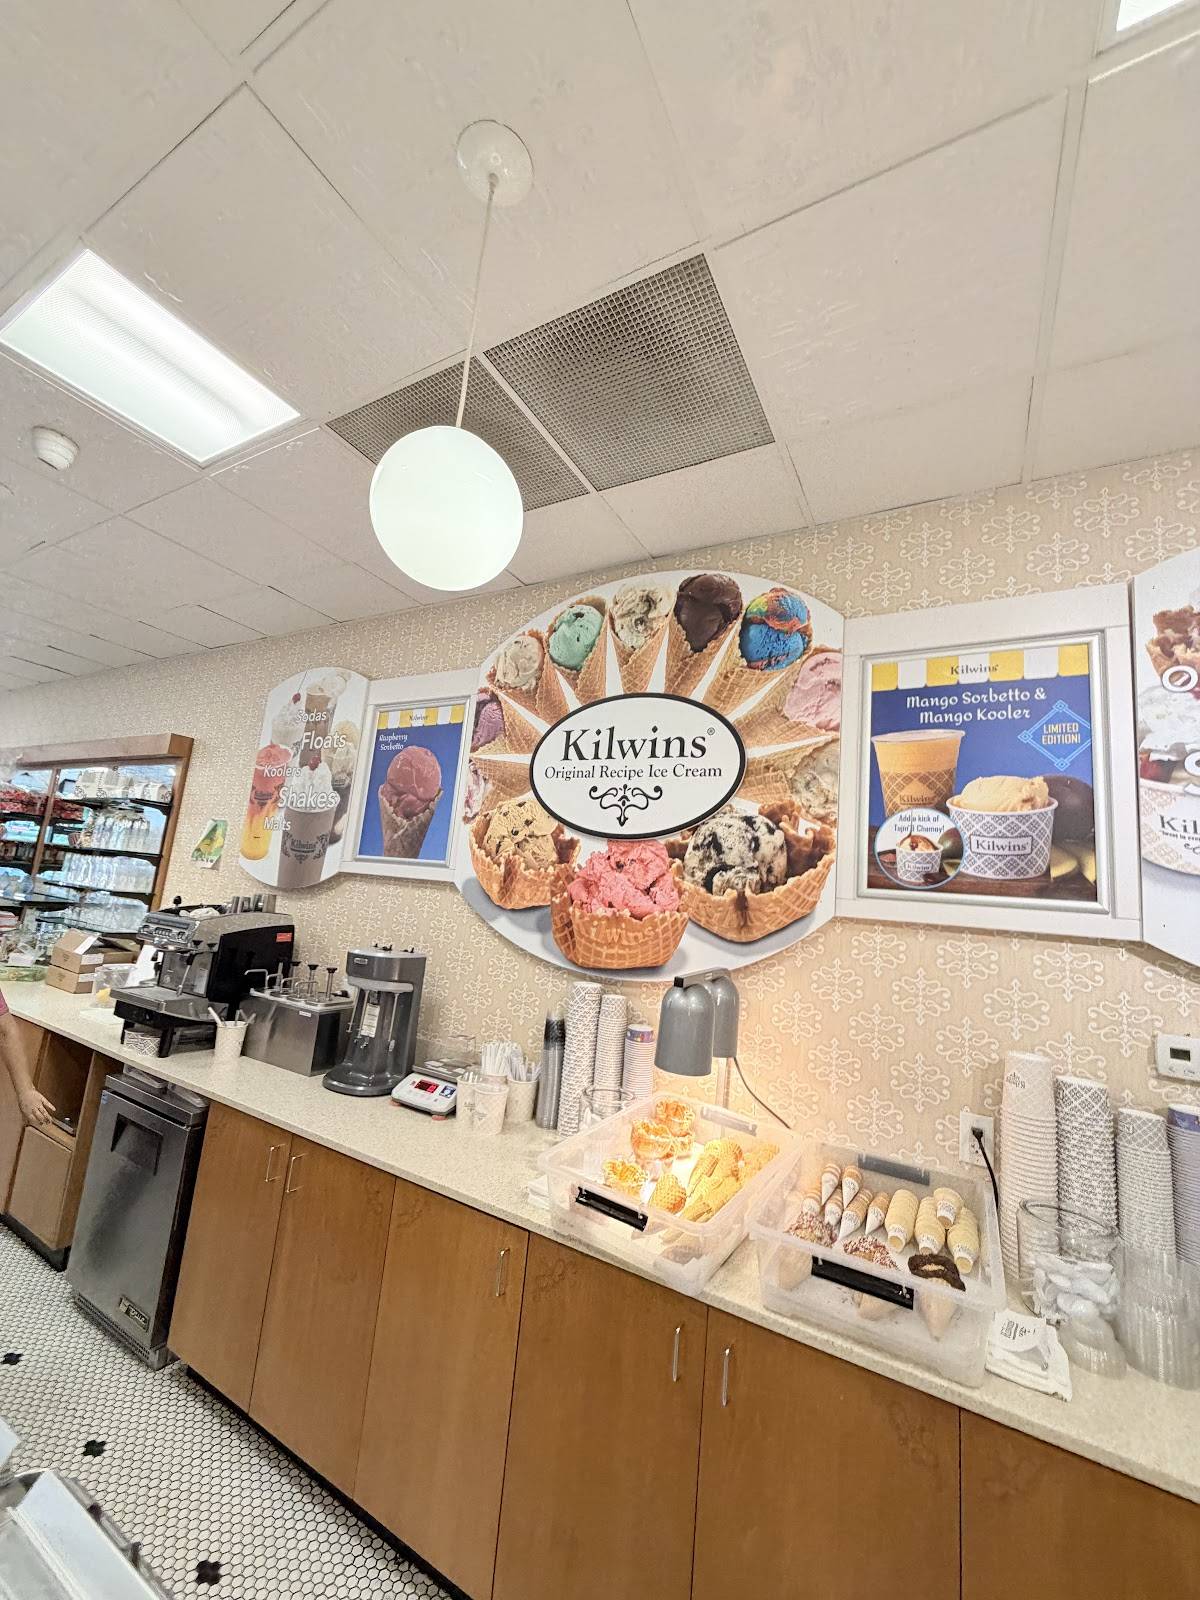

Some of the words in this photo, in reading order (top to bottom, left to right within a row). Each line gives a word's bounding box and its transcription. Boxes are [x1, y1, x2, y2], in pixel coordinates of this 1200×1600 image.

[950, 664, 999, 676] Kilwins
[906, 695, 958, 710] Mango
[962, 688, 1030, 705] Sorbetto
[1034, 687, 1047, 700] &
[296, 708, 327, 722] Sodas
[920, 710, 973, 726] Mango
[976, 704, 1031, 721] Kooler
[1043, 722, 1079, 734] LIMITED
[301, 731, 347, 750] Floats
[379, 731, 408, 743] Raspberry
[1042, 733, 1081, 745] EDITION!
[380, 743, 404, 751] Sorbetto
[263, 765, 302, 778] Koolers
[544, 765, 595, 781] Original
[600, 765, 644, 780] Recipe
[649, 764, 668, 778] Ice
[672, 764, 722, 778] Cream
[278, 786, 337, 808] Shakes
[264, 817, 292, 831] Malts
[1160, 814, 1200, 834] Kil
[976, 839, 1029, 852] Kilwins
